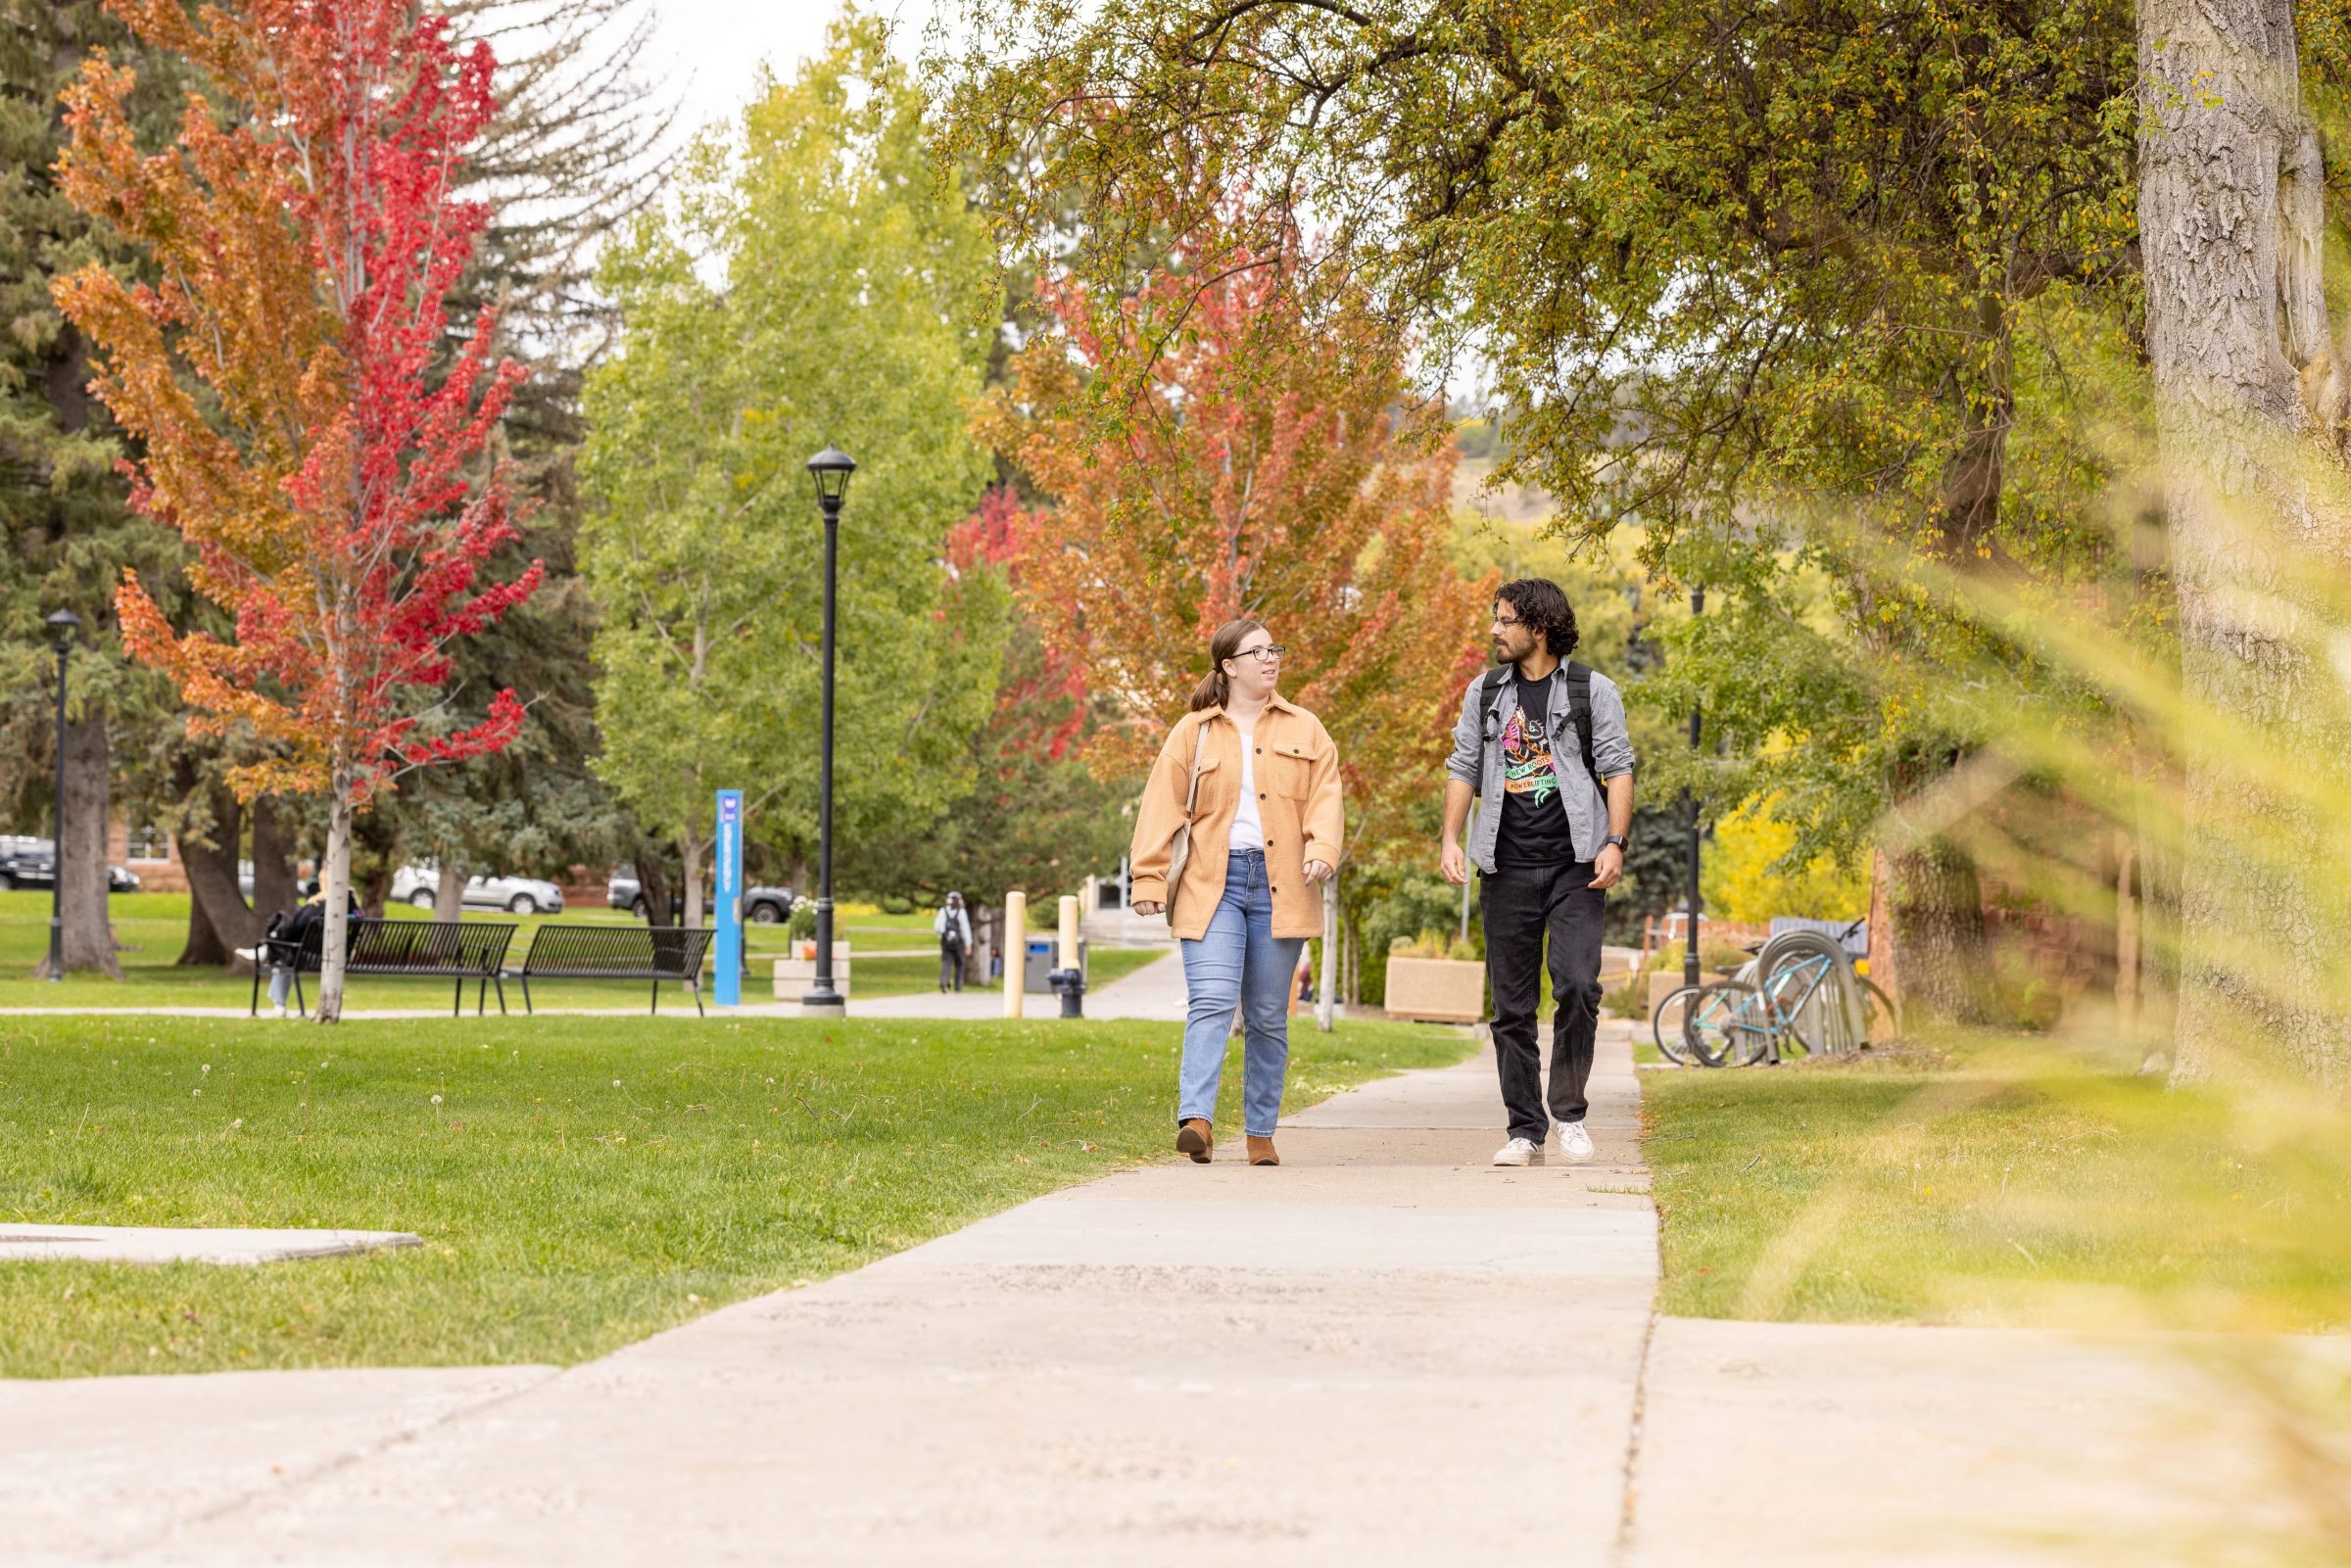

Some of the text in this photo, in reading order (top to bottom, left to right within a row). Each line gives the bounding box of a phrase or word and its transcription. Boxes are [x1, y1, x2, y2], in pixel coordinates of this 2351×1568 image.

[1511, 757, 1550, 777] NEW ROOTS
[1511, 778, 1556, 789] POWERLIFTING
